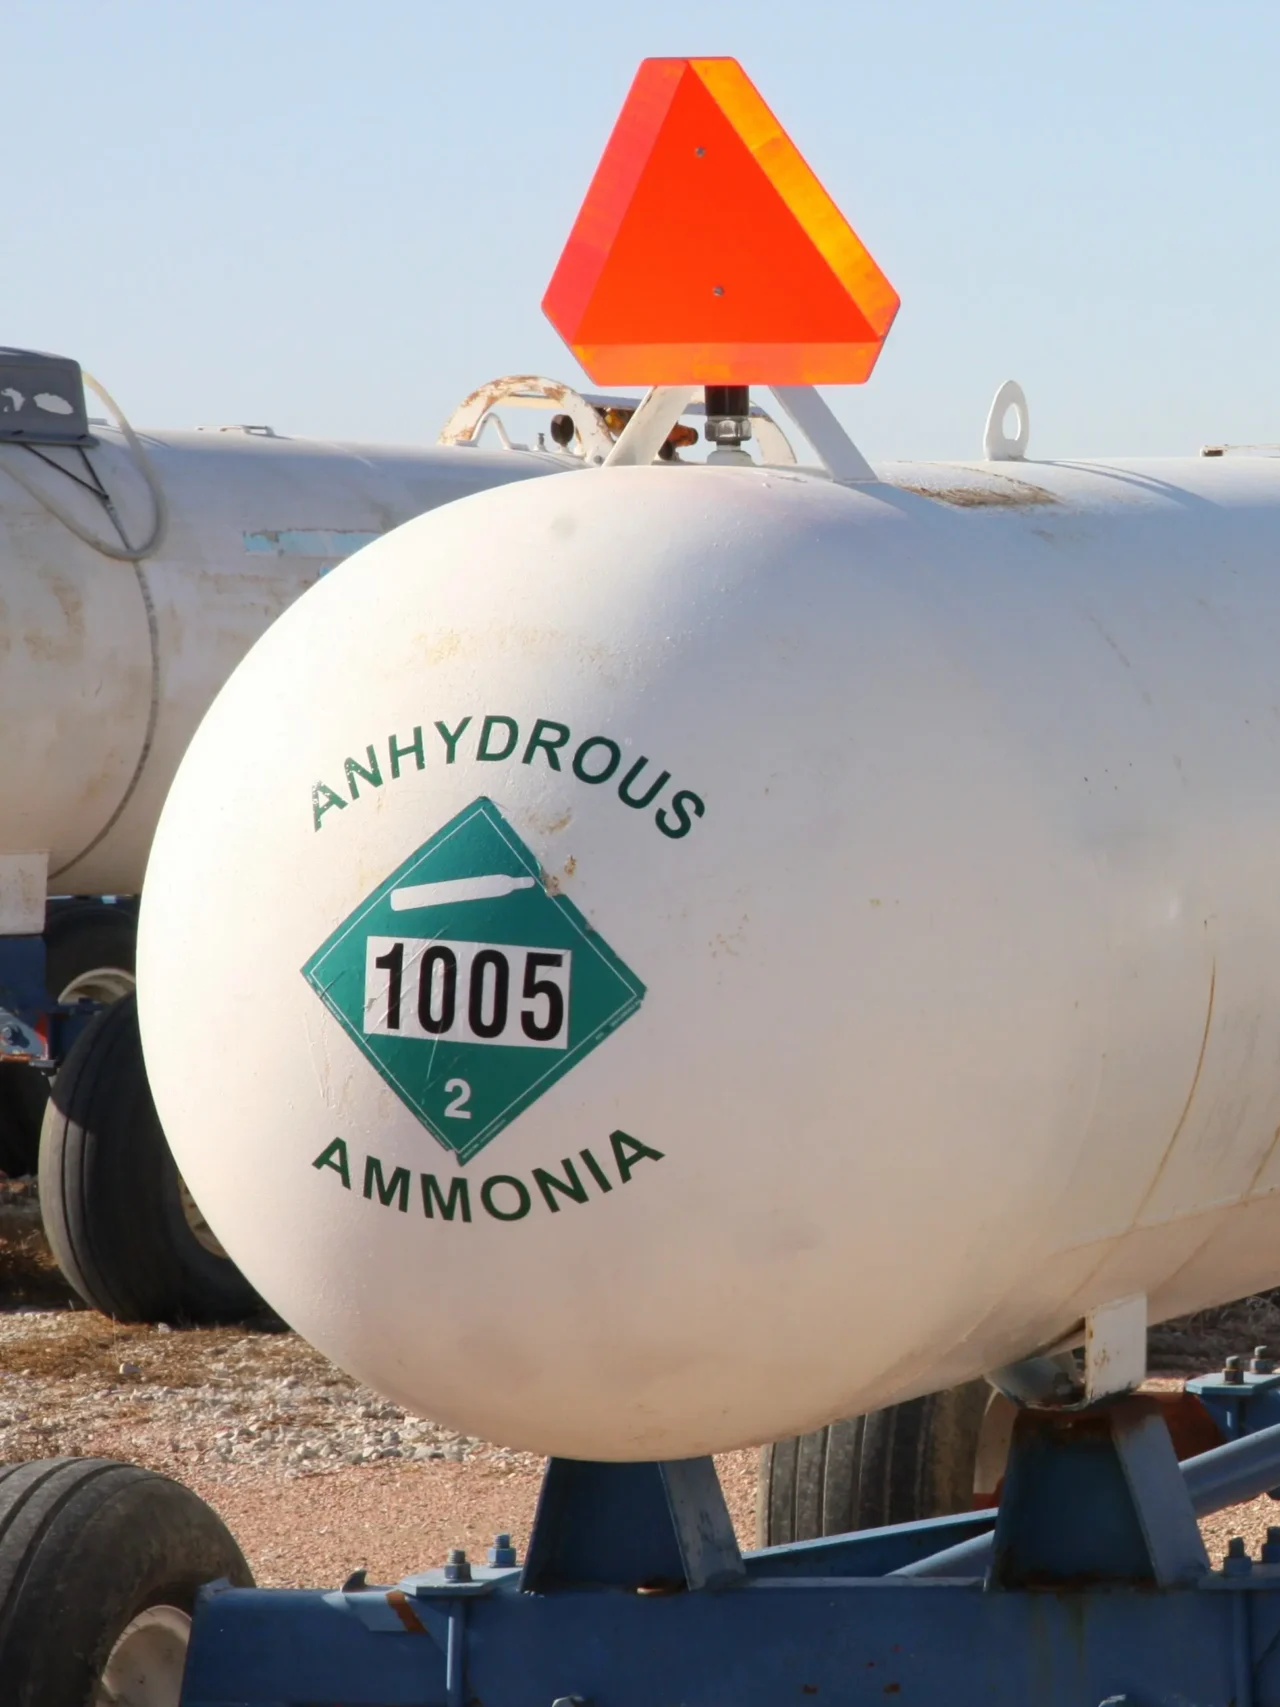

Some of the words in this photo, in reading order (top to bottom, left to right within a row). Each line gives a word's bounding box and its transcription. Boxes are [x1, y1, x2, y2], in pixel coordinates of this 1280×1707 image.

[312, 715, 706, 839] ANHYDROUS
[375, 943, 564, 1041] 1005
[444, 1078, 472, 1119] 2
[312, 1129, 665, 1223] AMMONIA
